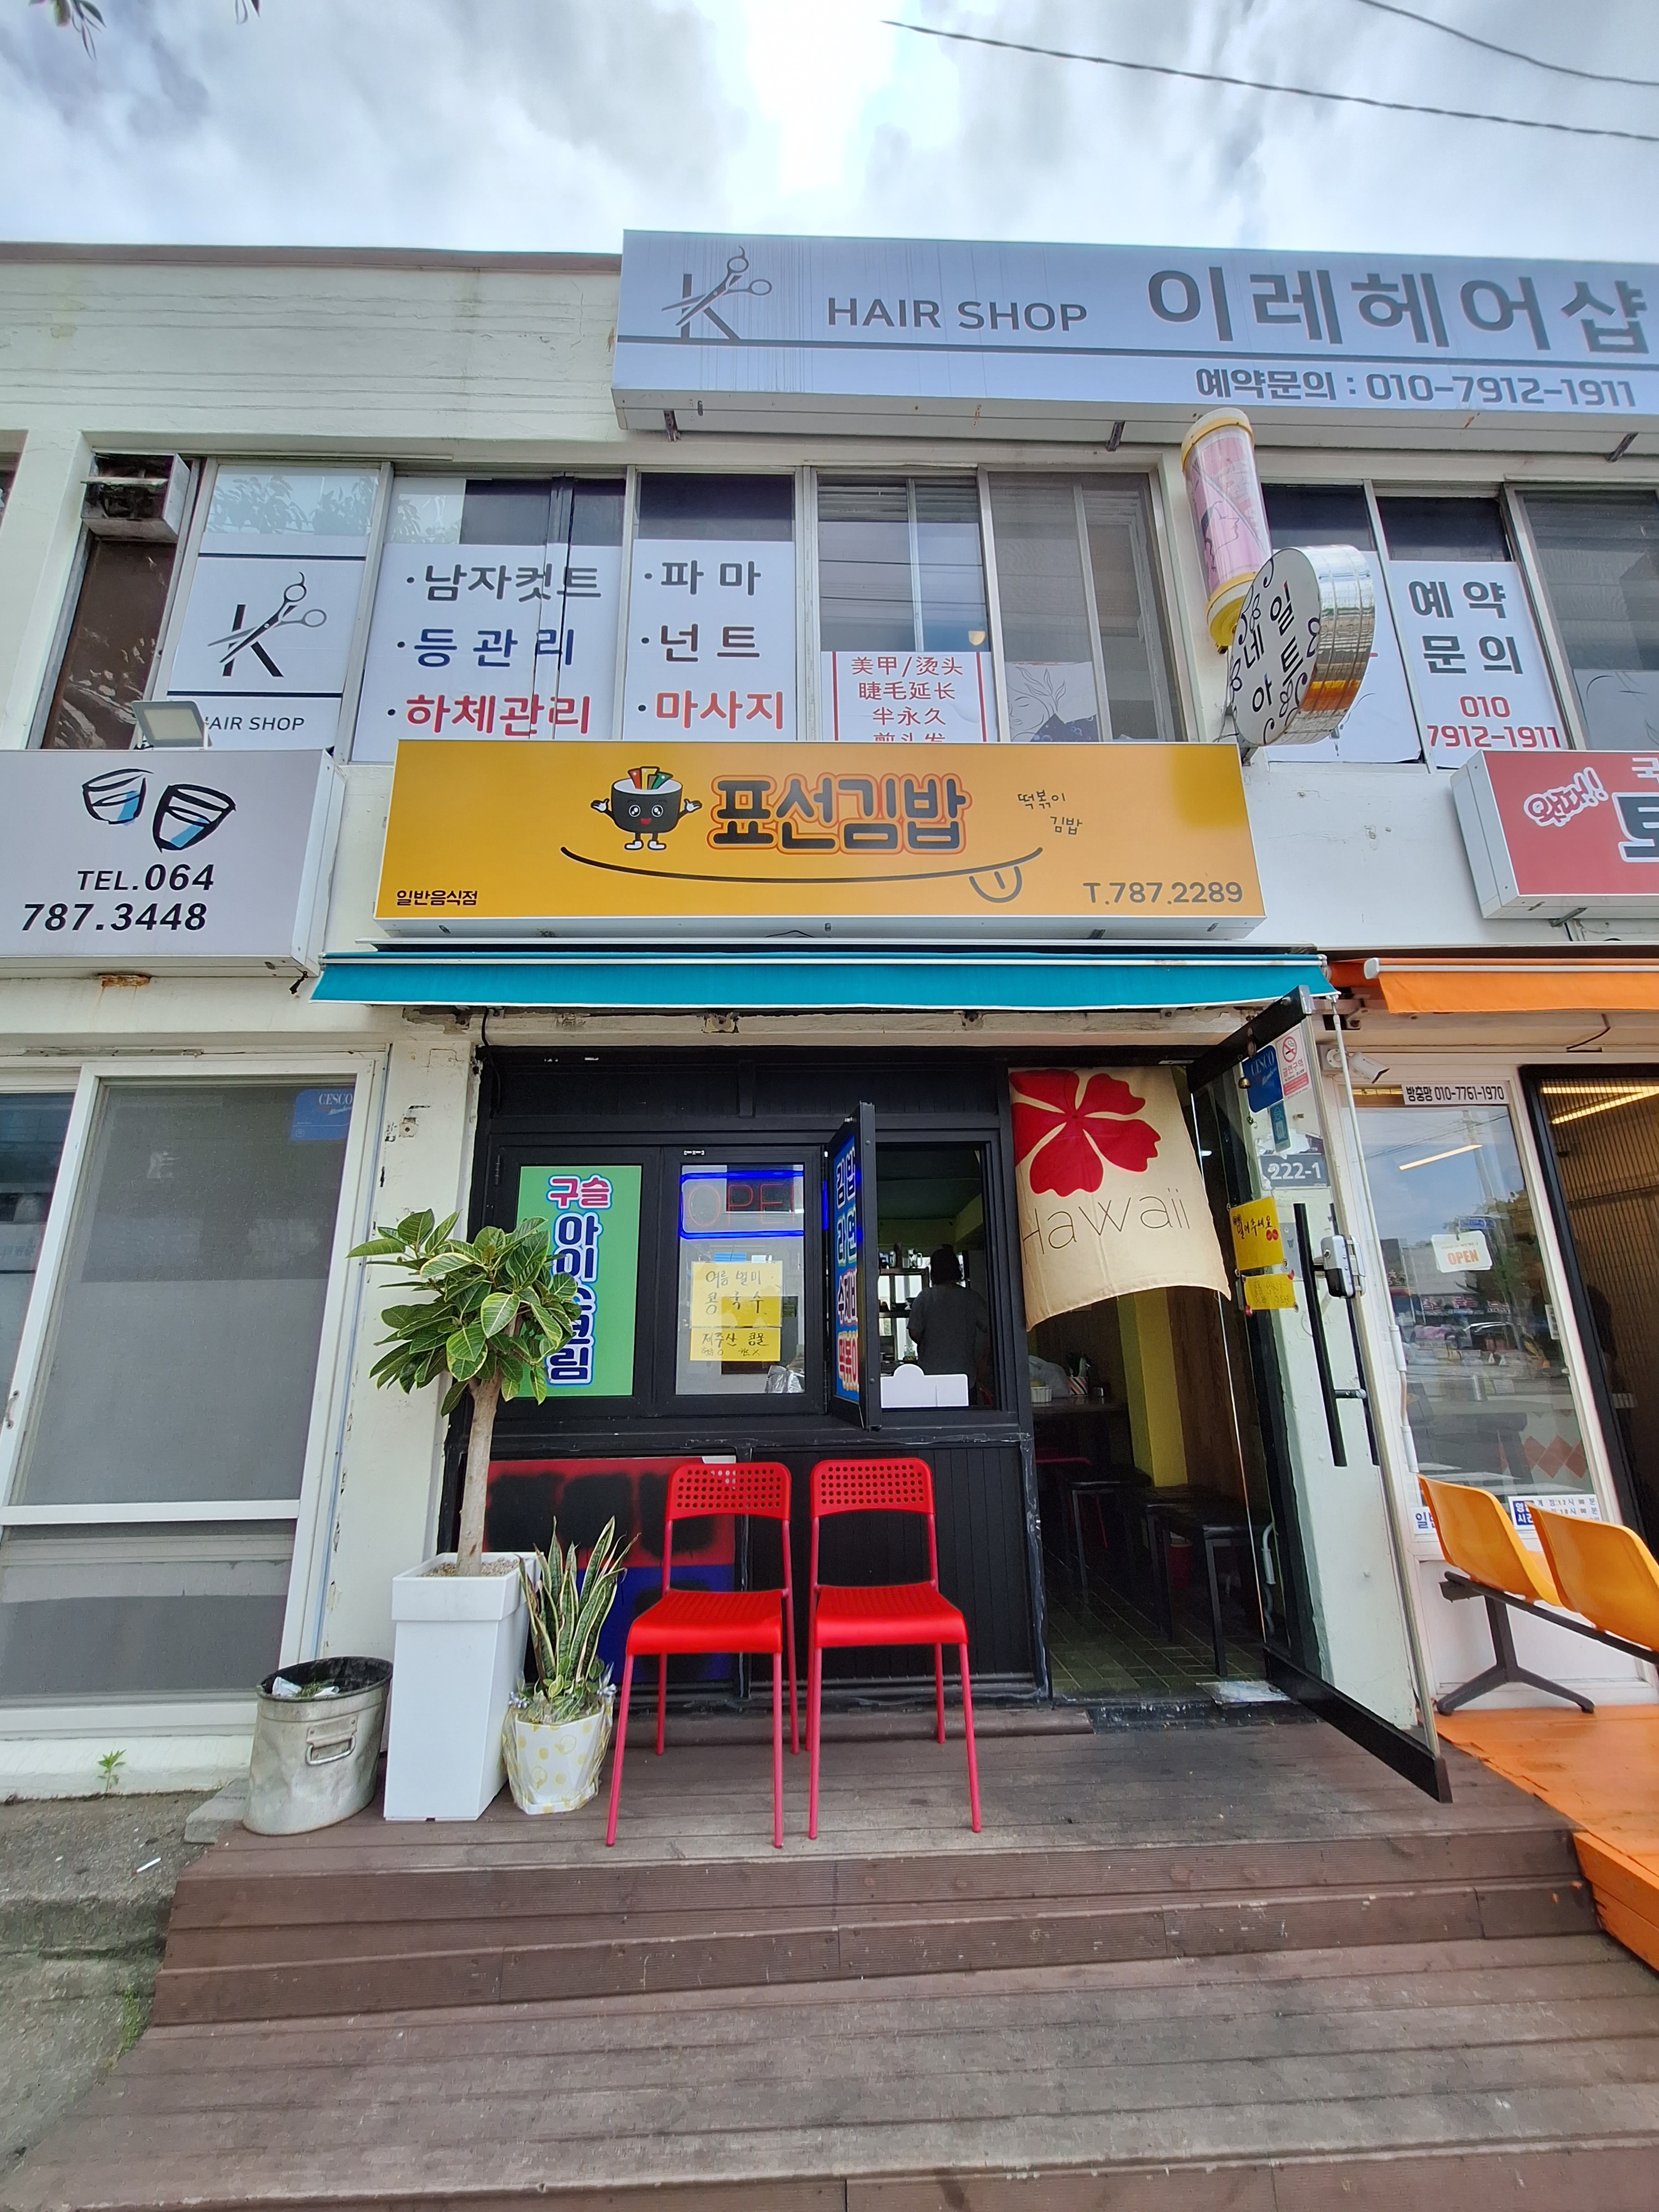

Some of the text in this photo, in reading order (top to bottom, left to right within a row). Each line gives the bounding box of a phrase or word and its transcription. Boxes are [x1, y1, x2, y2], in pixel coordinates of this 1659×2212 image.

[827, 297, 1088, 332] HAIR SHOP
[1147, 266, 1650, 354] 이레헤어샵
[1196, 367, 1336, 401] 예약문의
[1366, 373, 1637, 408] 010-7912-1911
[424, 563, 602, 602] 남자컷트
[851, 656, 964, 677] 美甲/烫头
[858, 681, 956, 701] 睫毛延长
[405, 693, 591, 737] 하체관리
[656, 690, 784, 729] 마사지
[872, 706, 947, 726] 半永久
[1459, 696, 1511, 718] 010
[248, 717, 305, 731] SHOP
[1427, 725, 1562, 748] 7912-1911
[1018, 789, 1066, 810] 떡볶이
[707, 773, 973, 855] 표선김밥
[1050, 816, 1083, 836] 김밥
[396, 890, 478, 906] 일반음식점
[1082, 881, 1244, 905] T.787.2289
[22, 903, 207, 931] 787.3448
[1250, 1050, 1275, 1076] CESCO
[1282, 1058, 1305, 1078] 금연구역
[318, 1093, 353, 1105] CESCO
[1406, 1086, 1505, 1102] 방충망 010-7761-1970
[1269, 1162, 1322, 1180] 222-1
[547, 1175, 613, 1209] 구슬
[1447, 1249, 1479, 1266] OPEN
[705, 1270, 761, 1288] 여름 별미
[702, 1332, 738, 1348] 제주산
